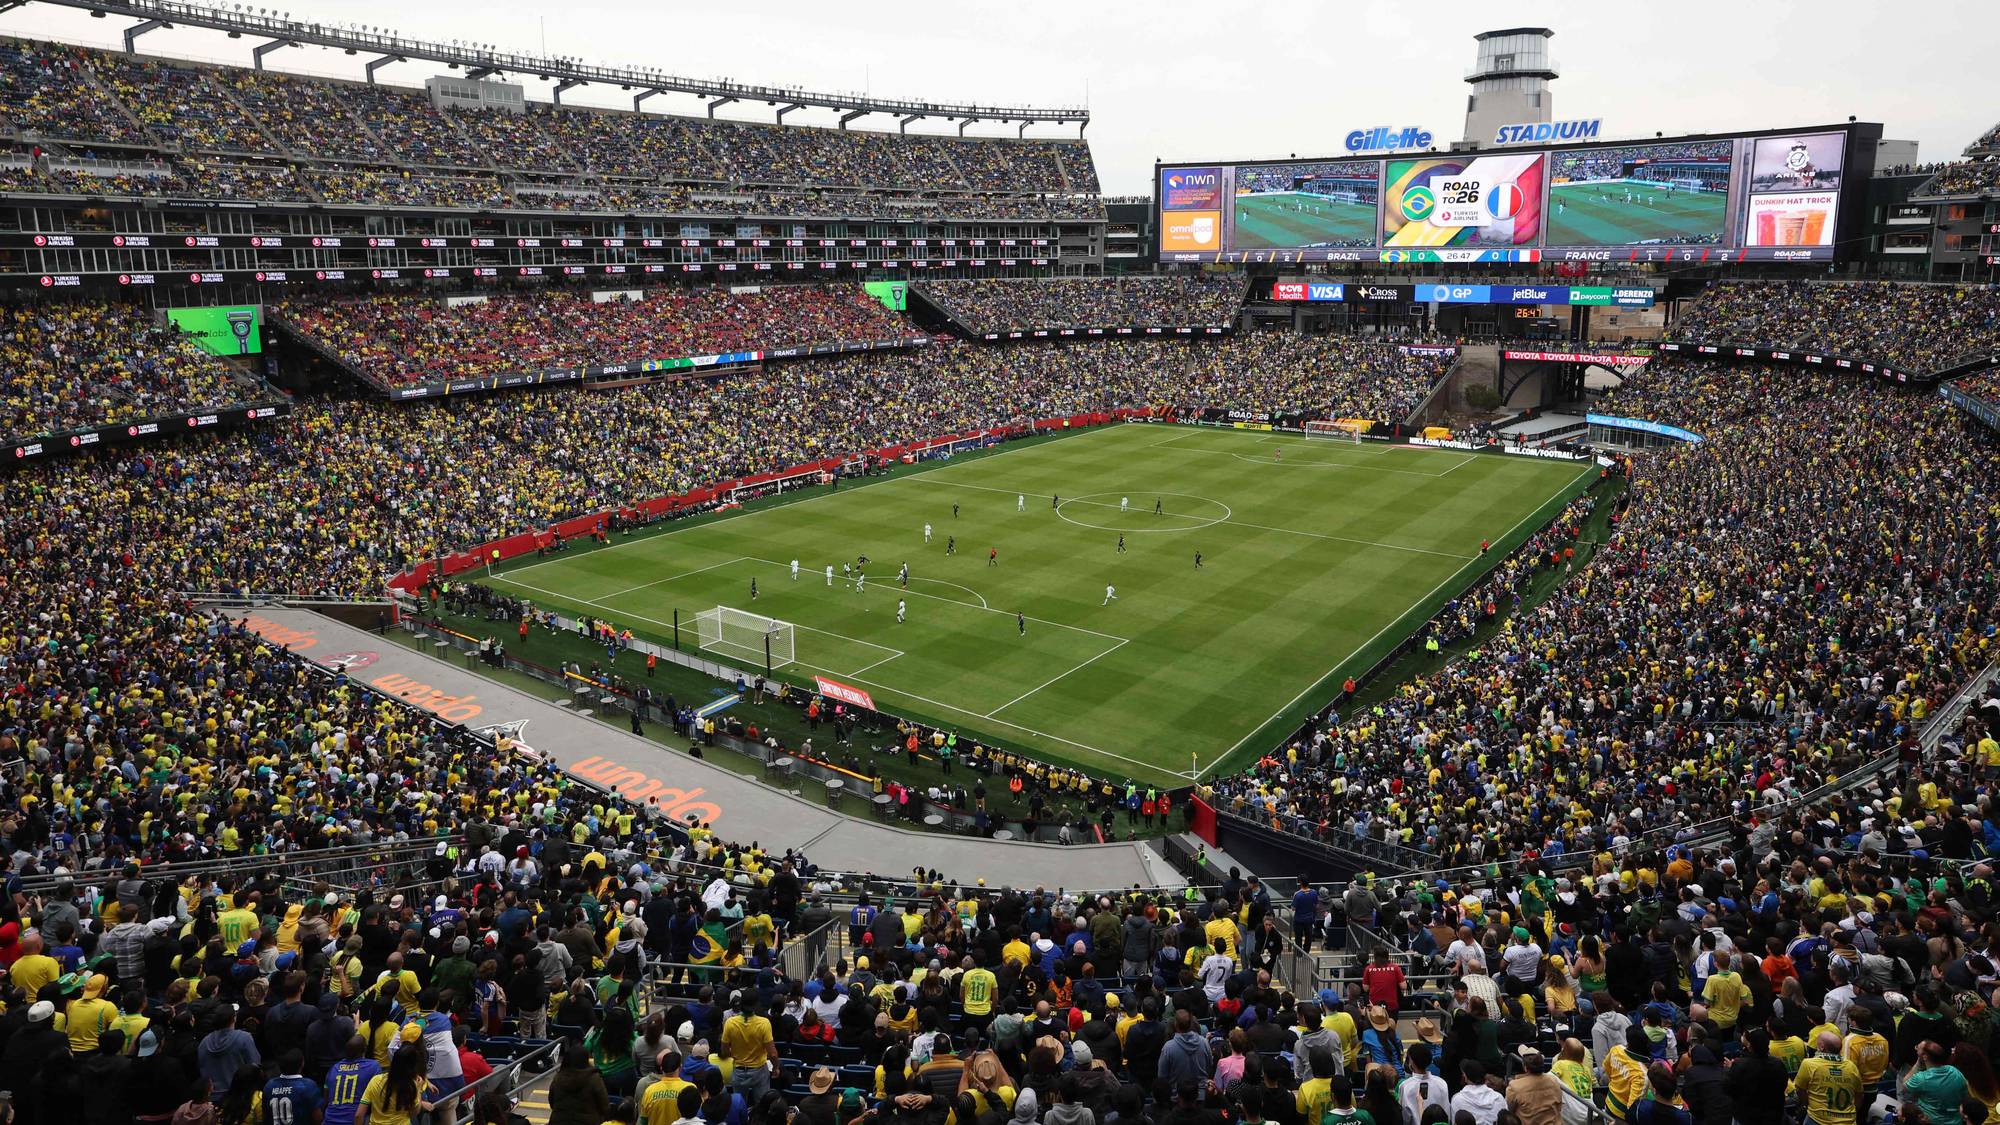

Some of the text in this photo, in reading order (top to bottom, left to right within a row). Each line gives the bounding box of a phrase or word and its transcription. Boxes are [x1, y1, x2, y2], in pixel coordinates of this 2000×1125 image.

[1496, 120, 1600, 144] STADIUM
[1345, 127, 1432, 150] Gillette
[1442, 180, 1480, 192] ROAD
[1442, 196, 1456, 204] TO
[1327, 252, 1361, 260] BRAZIL
[1565, 251, 1610, 260] FRANCE
[1310, 286, 1342, 298] VISA
[1512, 289, 1547, 300] jetBlue
[1516, 308, 1542, 318] 26:47
[1508, 352, 1649, 364] TOYOTA TOYOTA TOYOTA TOYOTA
[603, 365, 628, 374] BRAZIL
[452, 383, 475, 391] CORNERS
[1228, 411, 1252, 419] ROAD
[1409, 437, 1471, 449] NIKE.COM/FOOTBALL
[1504, 447, 1573, 459] NIKE.COM/FOOTBALL
[433, 915, 453, 926] ZIDANE
[858, 912, 867, 926] 10
[224, 923, 240, 944] 10
[1217, 966, 1226, 983] 7
[1027, 980, 1036, 997] 9
[332, 1074, 358, 1105] 10
[1826, 1087, 1851, 1110] 10
[270, 1097, 294, 1125] 10
